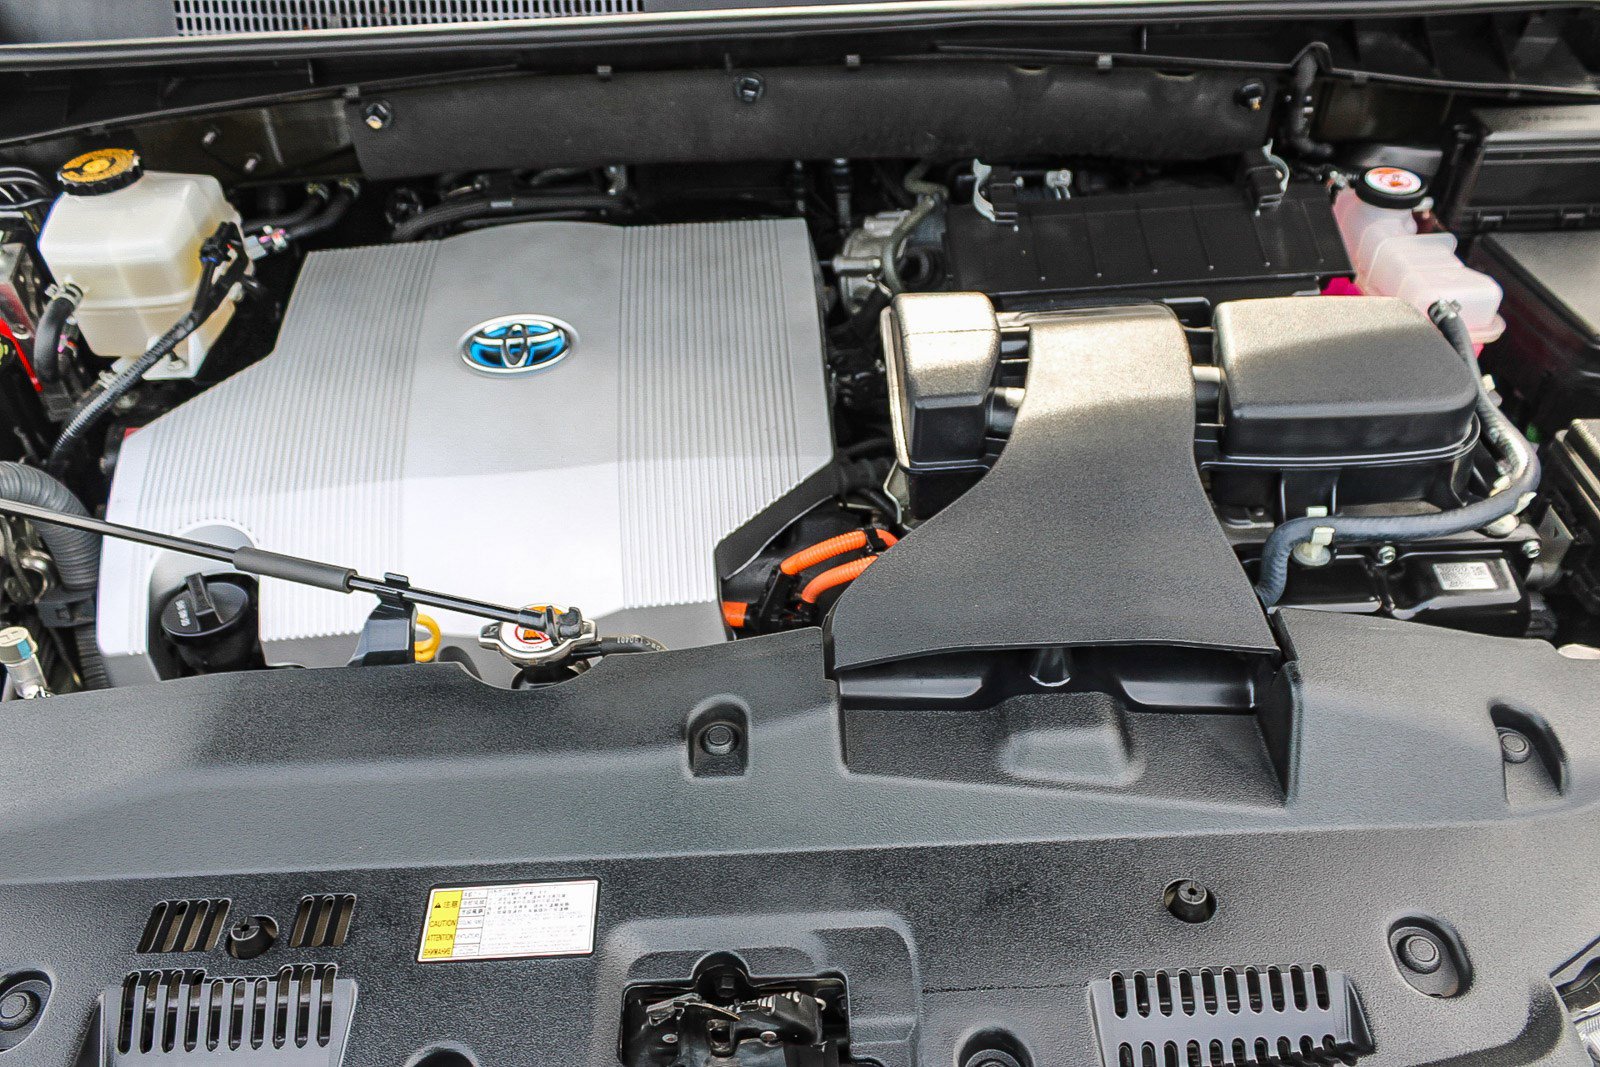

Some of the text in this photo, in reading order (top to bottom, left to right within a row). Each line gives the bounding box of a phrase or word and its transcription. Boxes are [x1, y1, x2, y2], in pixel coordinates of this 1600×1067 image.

[443, 900, 459, 909] 注意
[429, 919, 456, 928] CAUTION
[427, 933, 454, 941] ATTENTION
